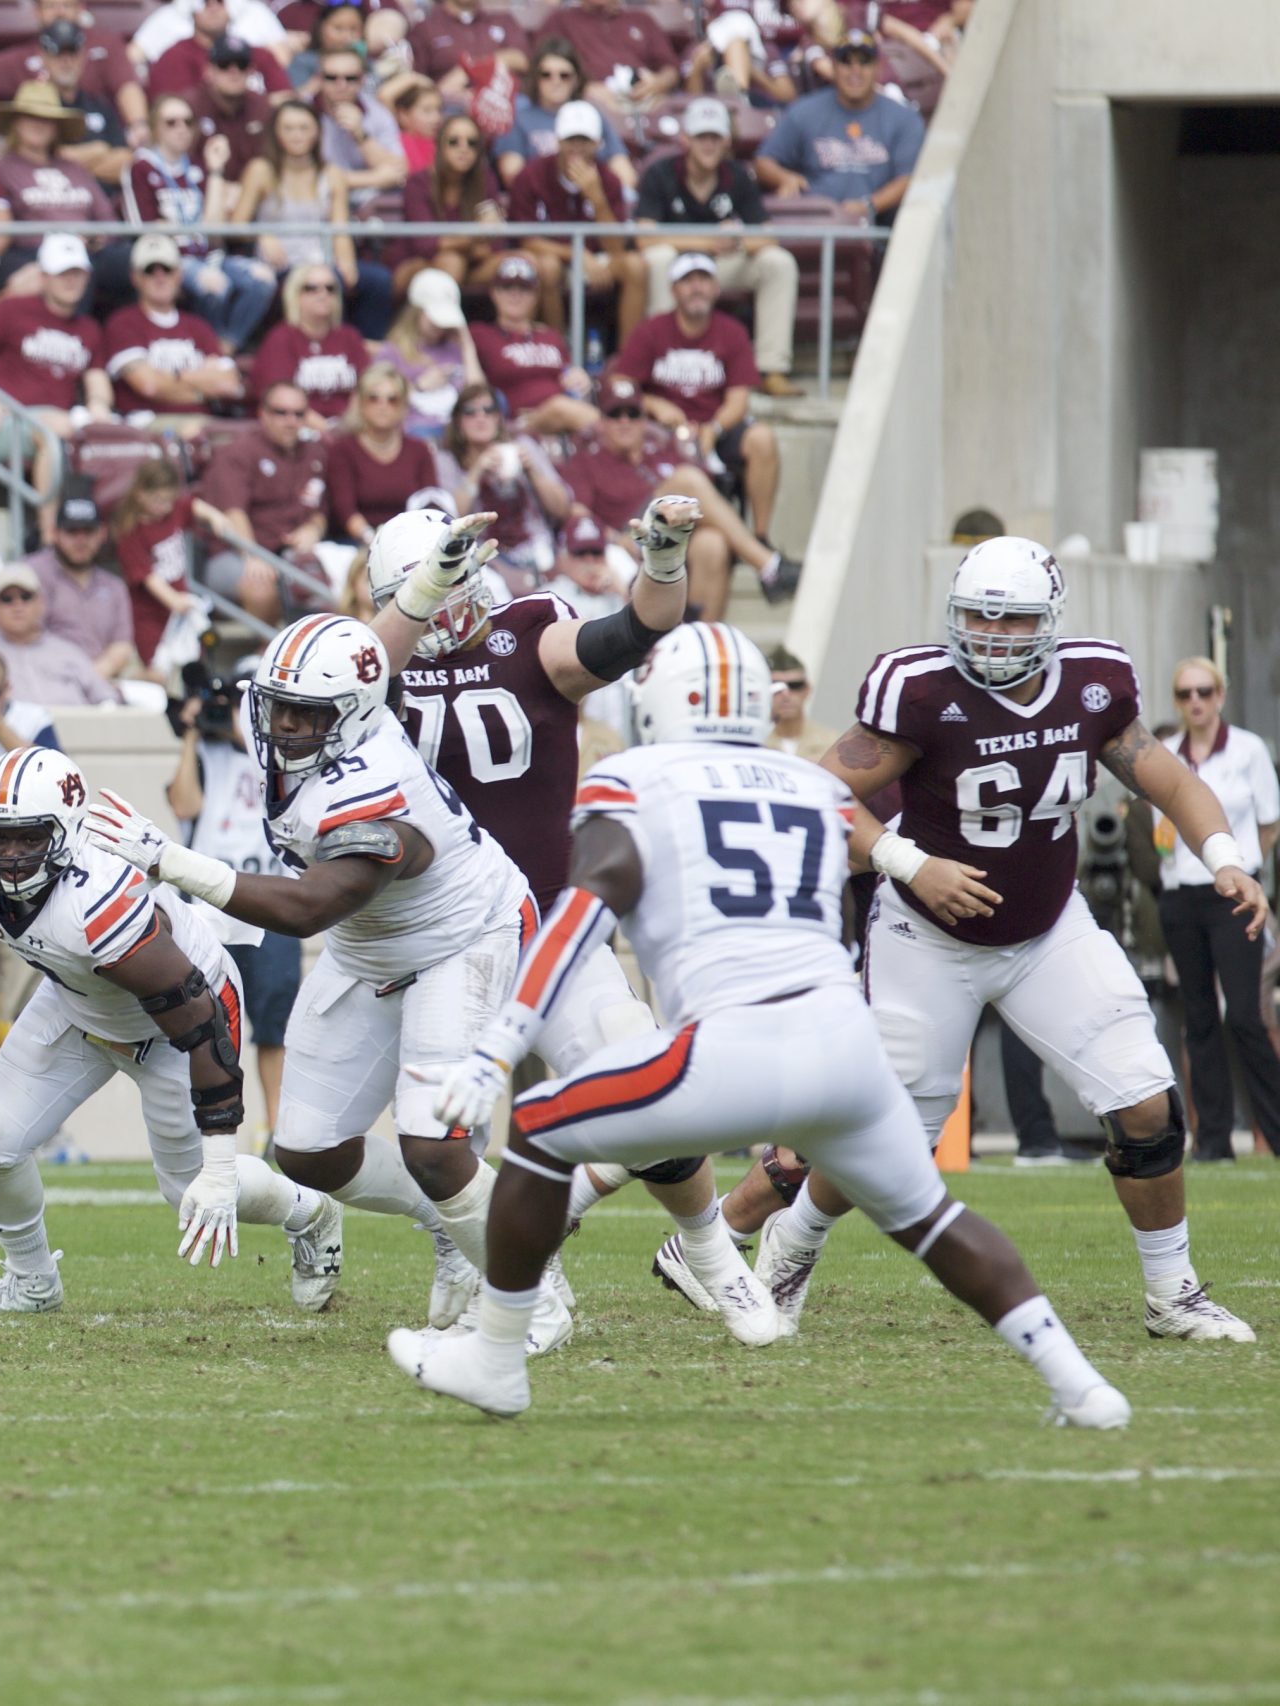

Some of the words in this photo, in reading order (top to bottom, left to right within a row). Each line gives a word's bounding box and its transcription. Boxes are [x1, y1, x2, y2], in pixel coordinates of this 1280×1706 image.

[487, 630, 517, 656] SEC
[454, 664, 490, 684] A&M
[403, 687, 533, 784] 70
[975, 735, 1037, 756] TEXAS
[1043, 723, 1080, 746] A&M
[321, 754, 369, 786] 95
[734, 765, 798, 794] DAVIS
[955, 752, 1088, 848] 64
[64, 864, 90, 888] 3
[698, 799, 826, 921] 57
